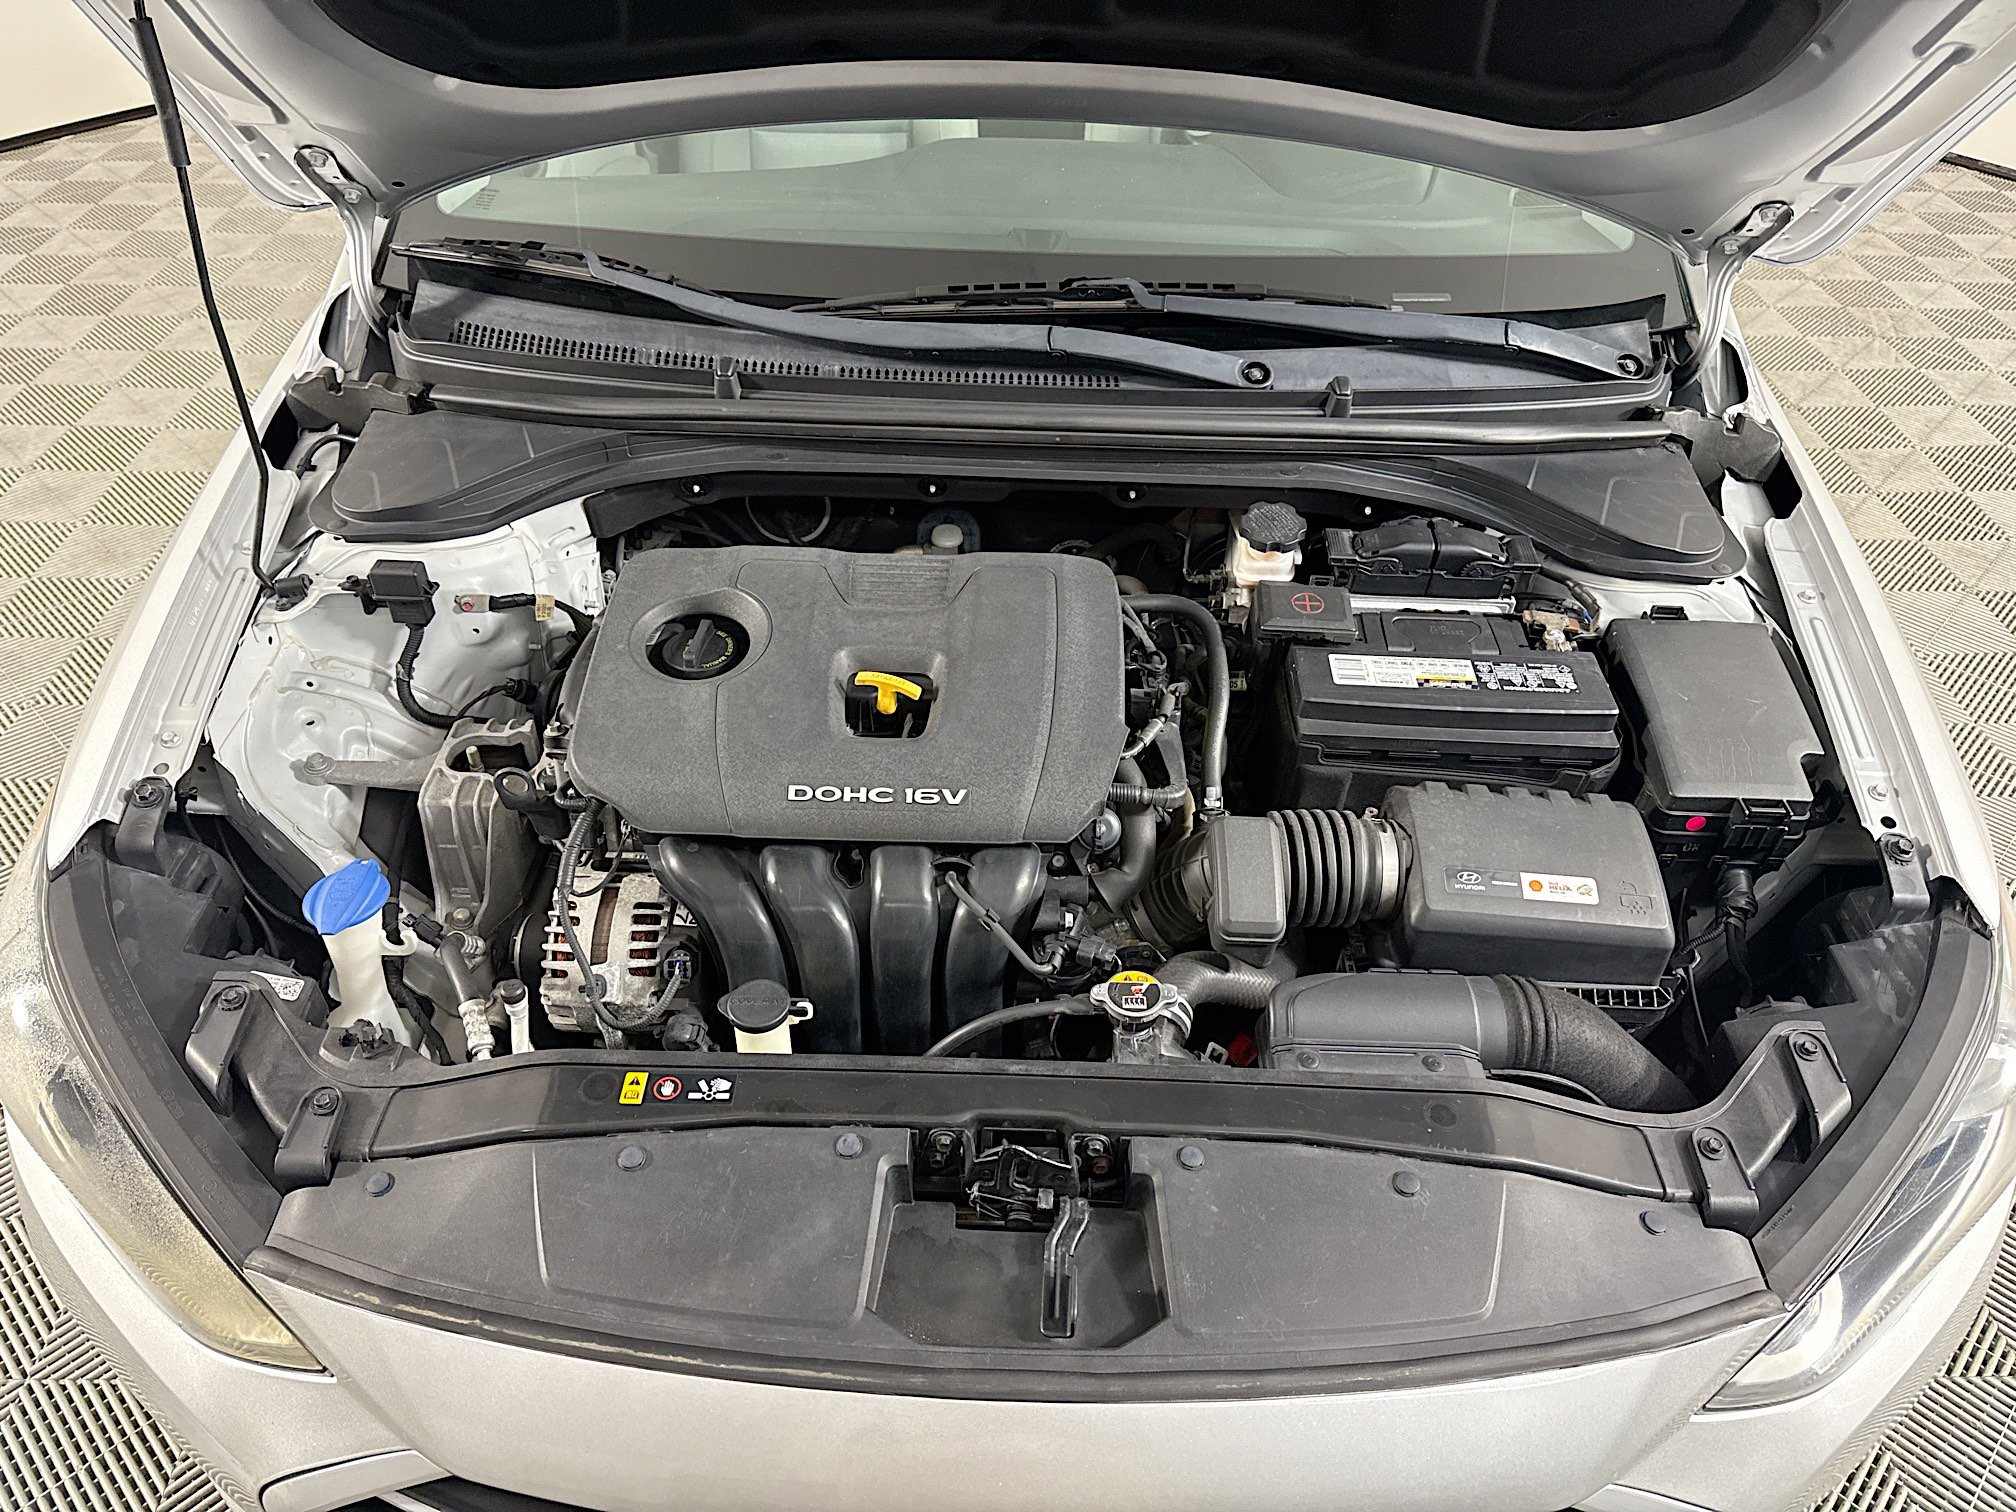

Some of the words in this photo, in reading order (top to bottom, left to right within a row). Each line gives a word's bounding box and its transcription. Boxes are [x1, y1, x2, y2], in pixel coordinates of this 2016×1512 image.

[787, 784, 894, 803] DOHC
[904, 787, 968, 805] 16V
[1454, 883, 1486, 891] HYUNDAI
